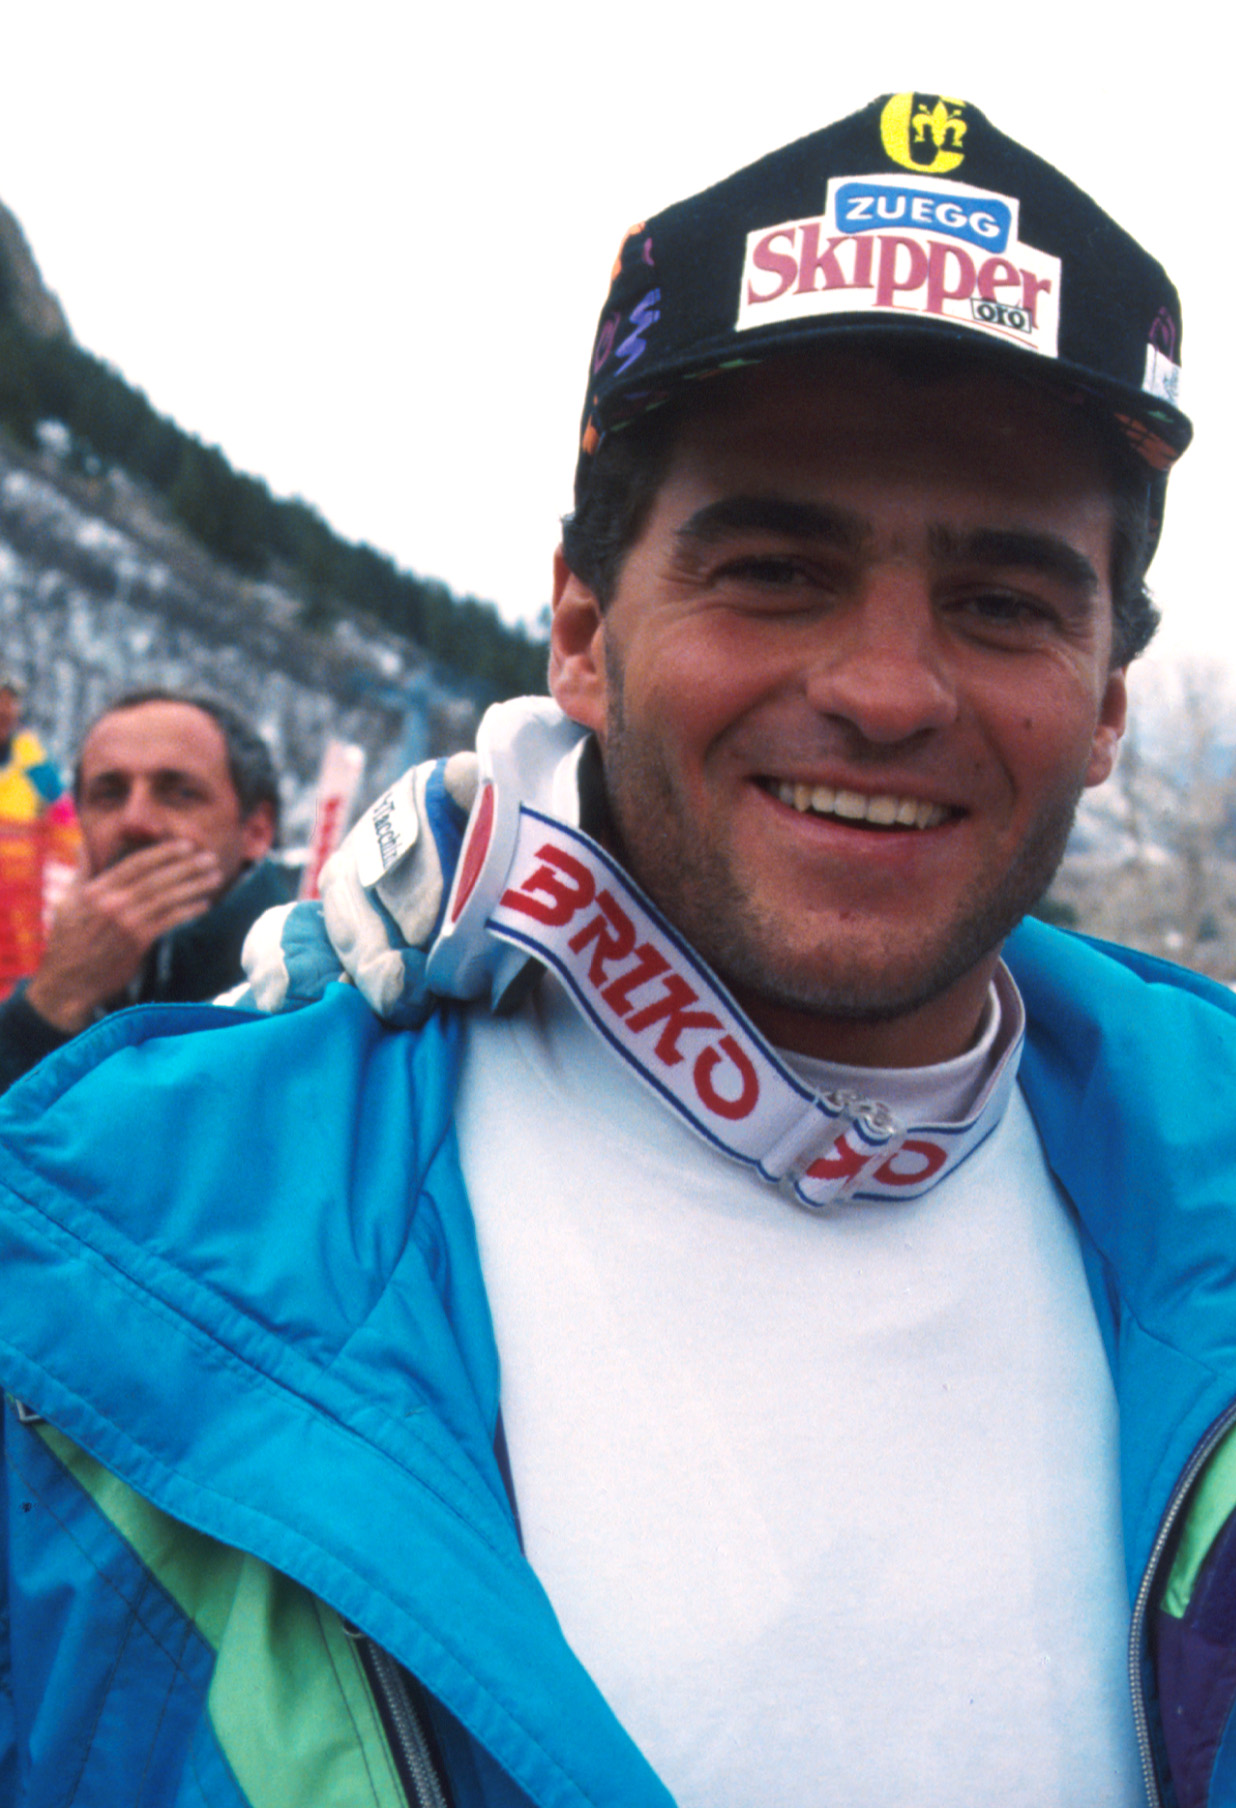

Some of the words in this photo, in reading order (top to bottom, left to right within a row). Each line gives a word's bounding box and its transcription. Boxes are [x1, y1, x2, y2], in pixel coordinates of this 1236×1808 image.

[844, 196, 1001, 240] ZUEGG
[746, 222, 1053, 330] Skipper
[499, 843, 760, 1121] BRIKO
